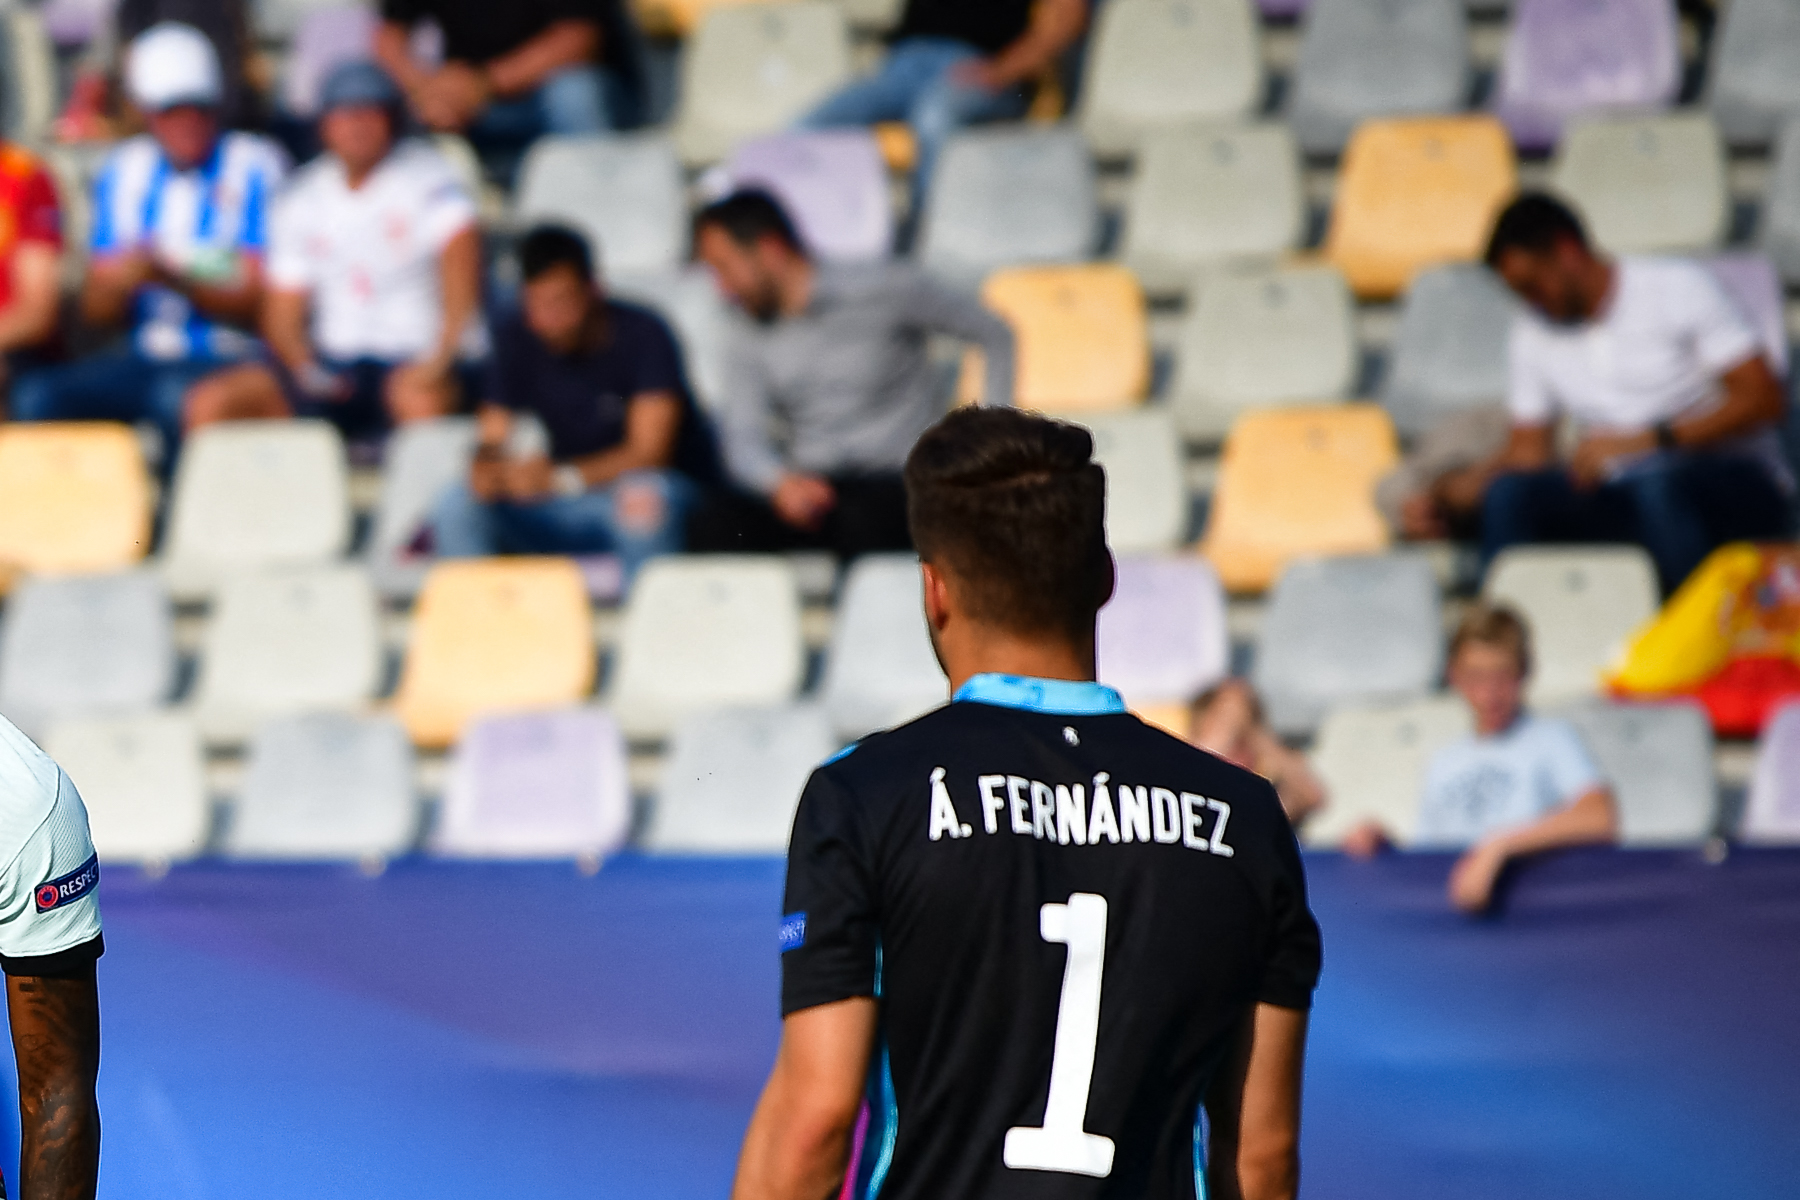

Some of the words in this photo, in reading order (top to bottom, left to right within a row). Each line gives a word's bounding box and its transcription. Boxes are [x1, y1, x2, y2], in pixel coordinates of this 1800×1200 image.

[929, 766, 973, 841] Á.
[978, 771, 1235, 859] FERNÁNDEZ
[59, 861, 98, 899] RESPEC
[1003, 892, 1116, 1179] 1
